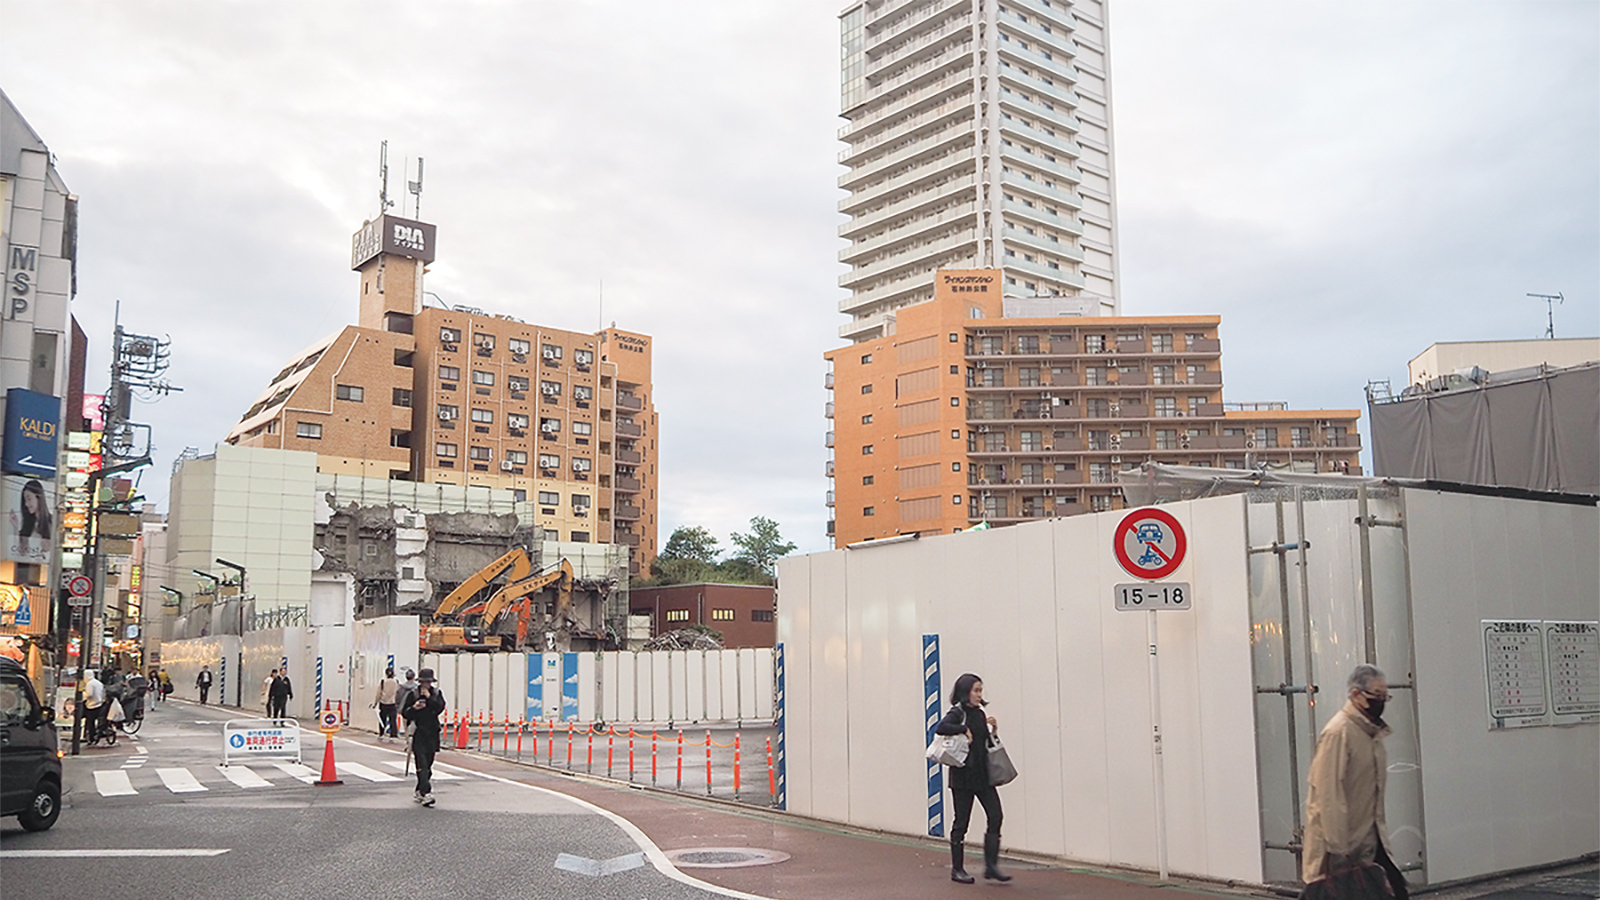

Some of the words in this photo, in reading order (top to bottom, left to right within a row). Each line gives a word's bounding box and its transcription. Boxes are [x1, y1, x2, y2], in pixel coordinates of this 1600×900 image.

[394, 224, 425, 244] DIA
[10, 247, 36, 321] MSP
[20, 417, 56, 437] KALDI
